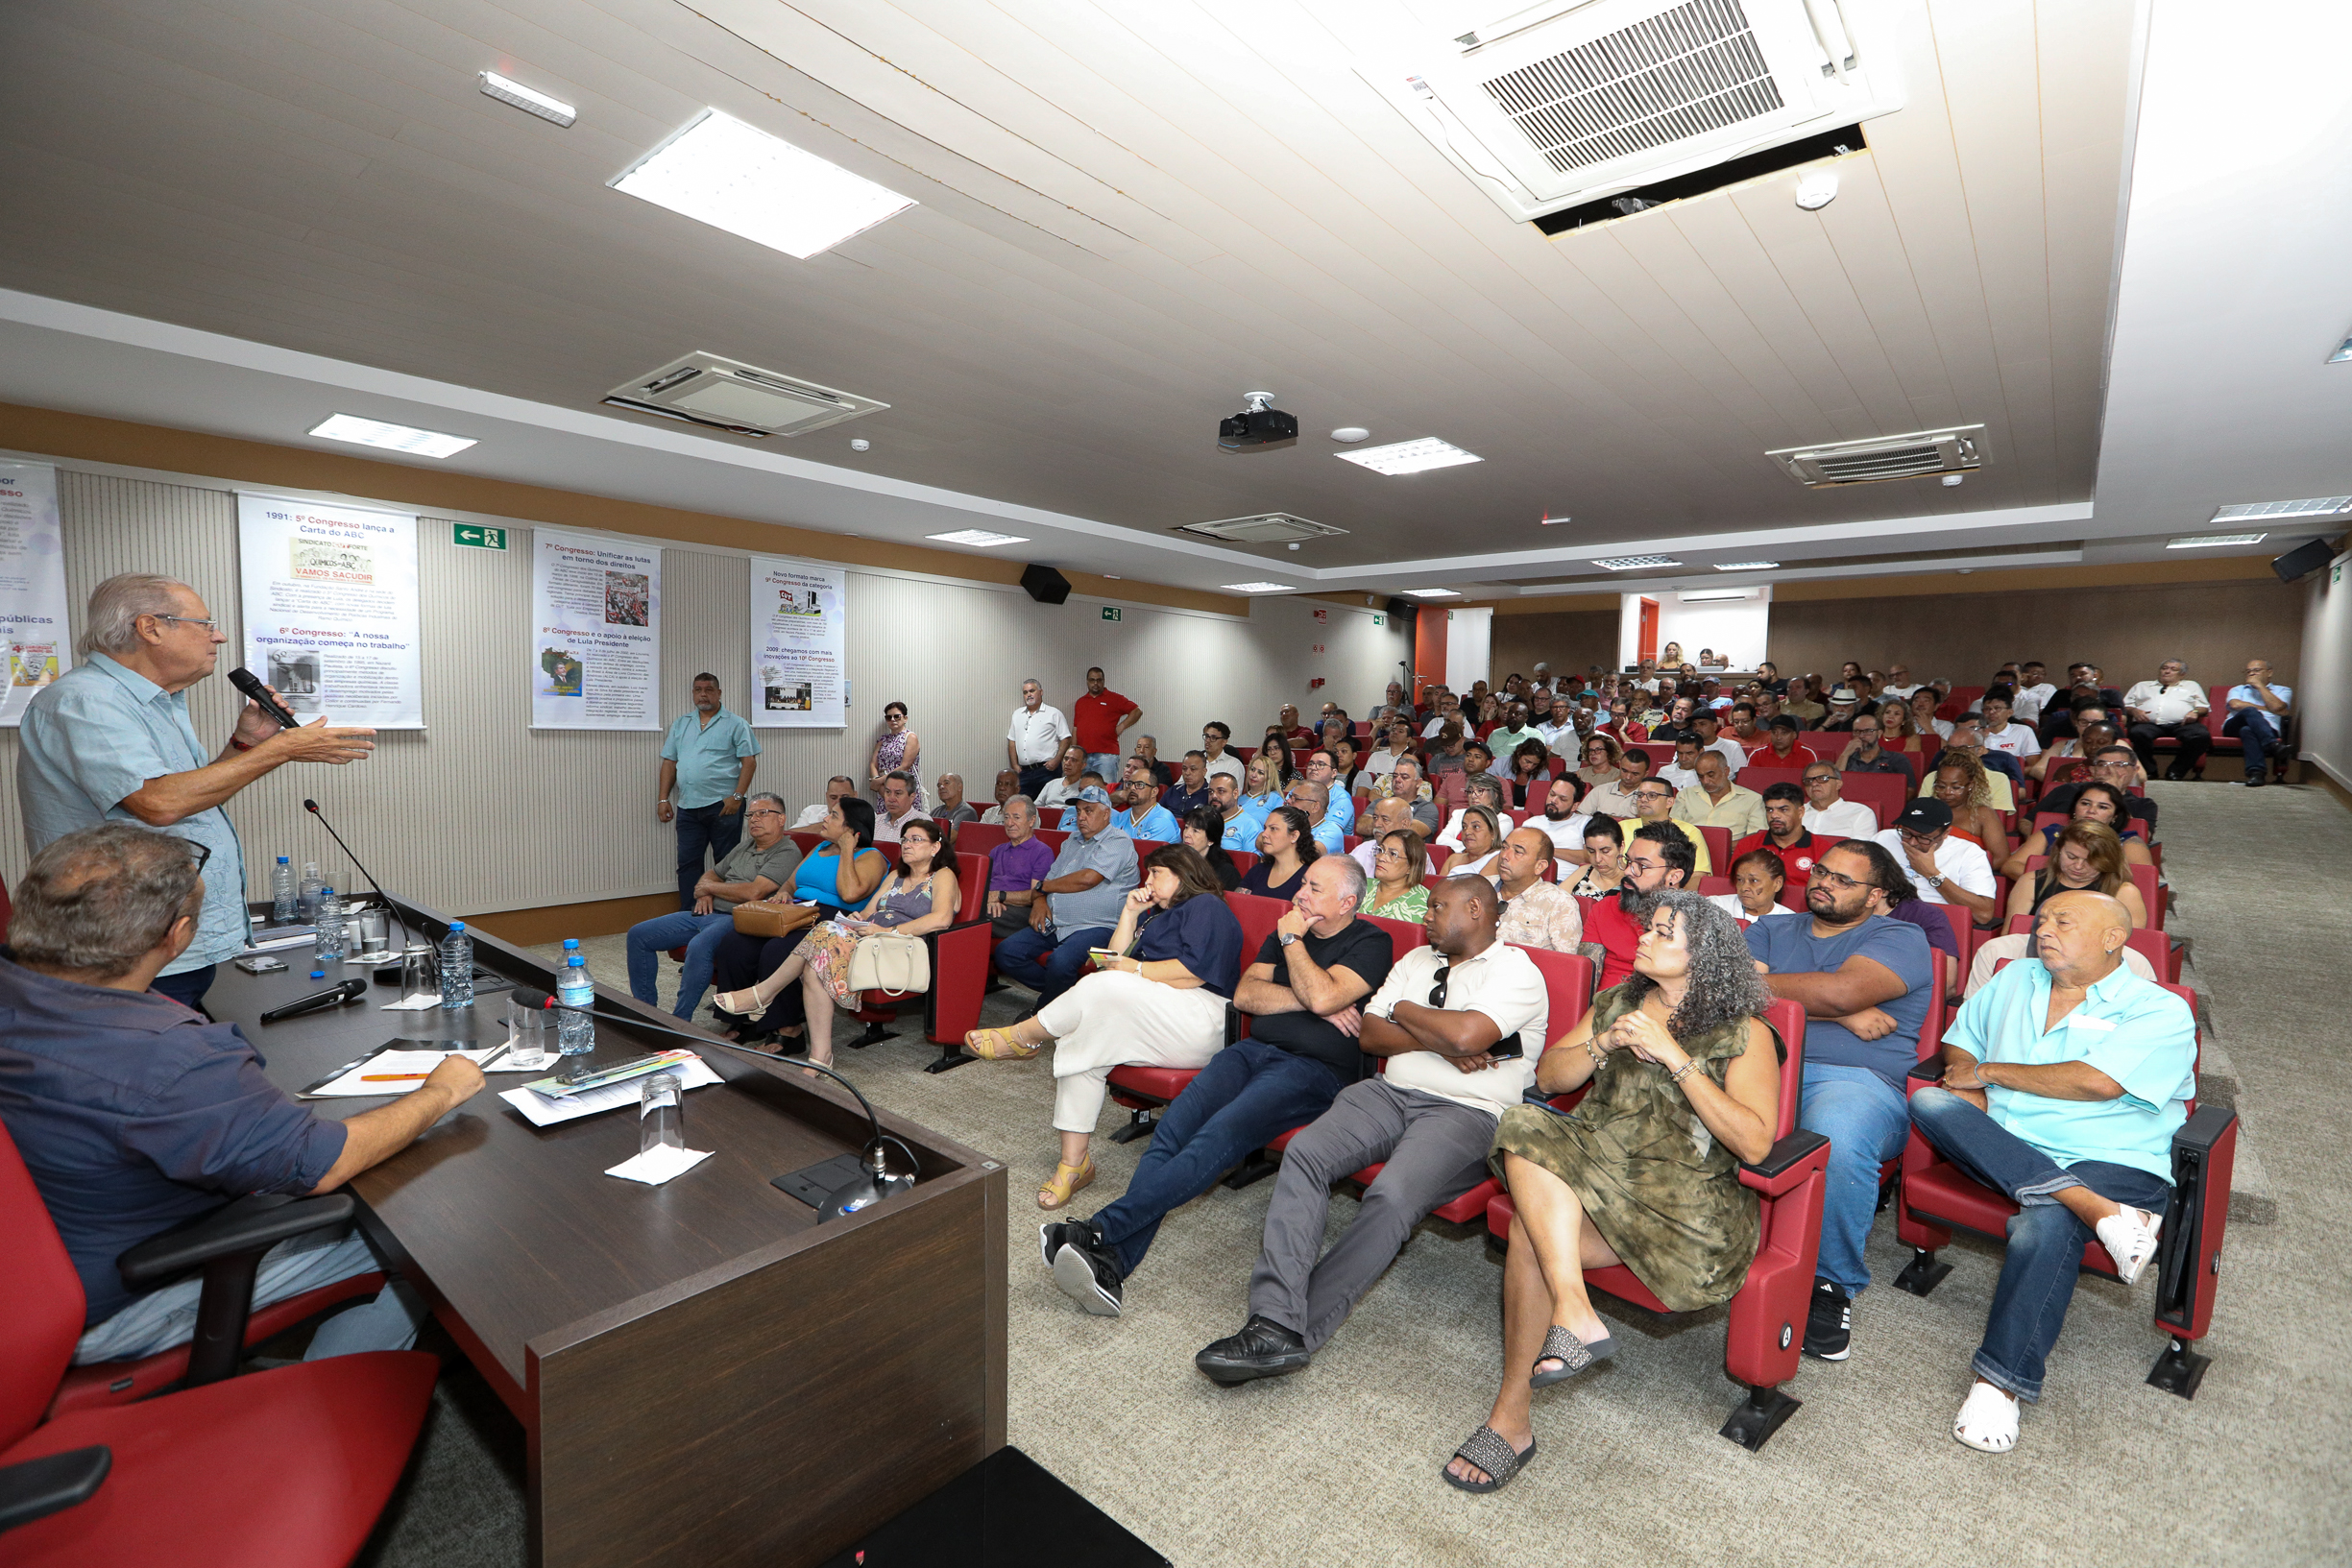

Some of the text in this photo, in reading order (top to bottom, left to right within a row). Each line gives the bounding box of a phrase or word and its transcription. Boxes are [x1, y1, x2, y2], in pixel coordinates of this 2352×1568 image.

[308, 516, 359, 528] Congresso
[362, 522, 386, 532] lança
[300, 526, 325, 534] Carta
[344, 530, 363, 538] ABC
[597, 550, 623, 559] Unificar
[610, 561, 635, 569] direitos
[295, 568, 330, 576] VAMOS
[333, 571, 373, 580] SACUDIR
[551, 628, 590, 636] Congresso
[256, 638, 315, 646] organização
